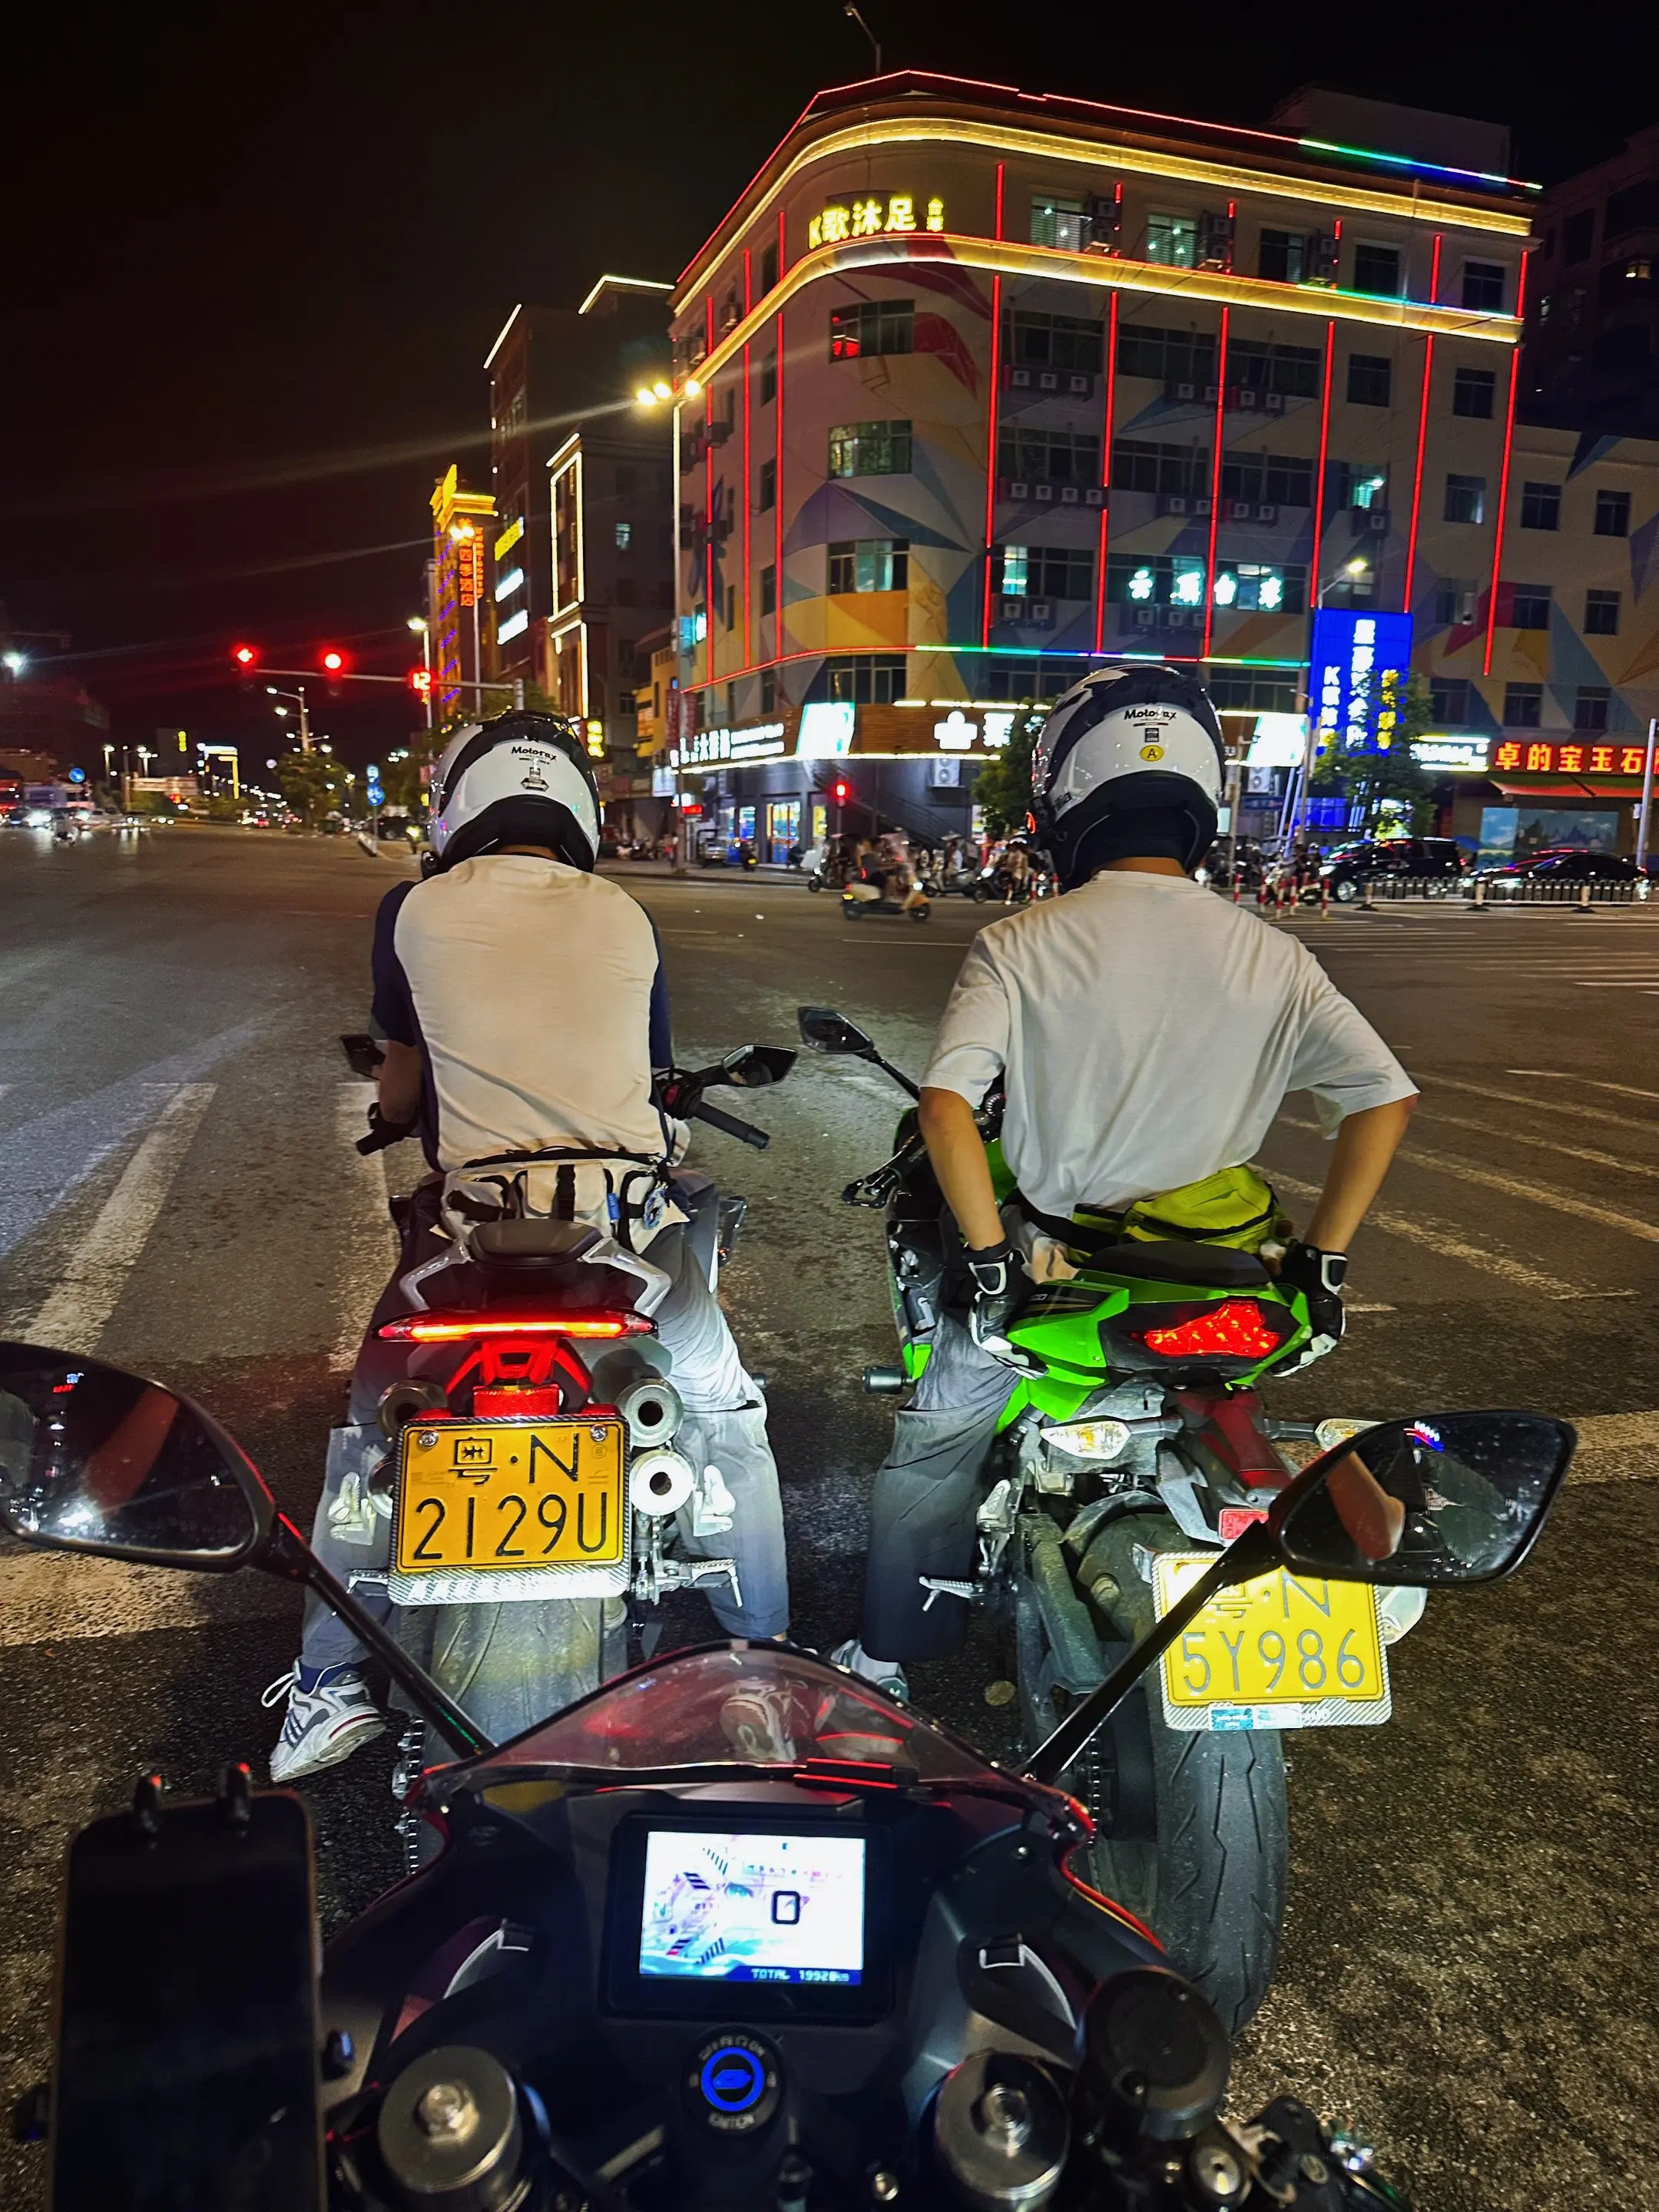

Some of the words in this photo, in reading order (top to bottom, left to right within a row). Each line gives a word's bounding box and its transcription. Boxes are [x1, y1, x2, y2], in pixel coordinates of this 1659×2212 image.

[412, 672, 431, 690] 12
[511, 746, 557, 761] Motorax
[1147, 747, 1157, 759] A
[1495, 741, 1659, 775] 卓的宝玉石
[413, 1492, 607, 1560] 2129U
[1182, 1628, 1365, 1694] 5Y986
